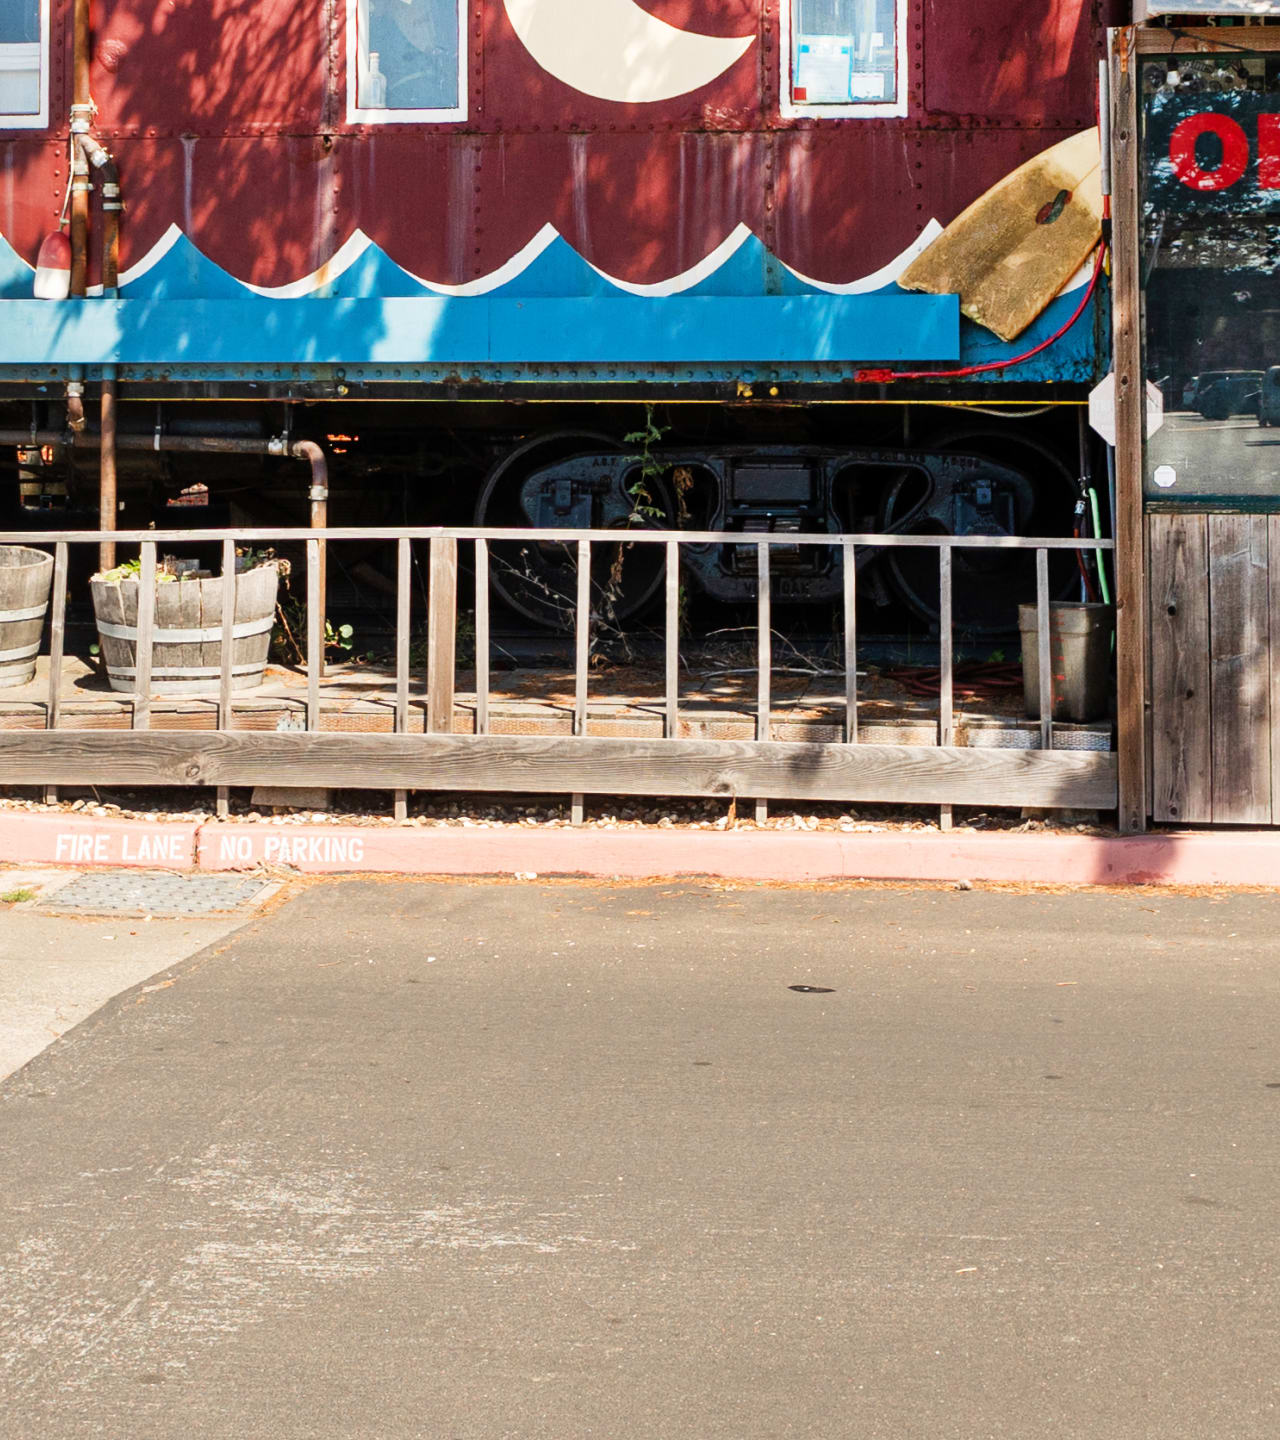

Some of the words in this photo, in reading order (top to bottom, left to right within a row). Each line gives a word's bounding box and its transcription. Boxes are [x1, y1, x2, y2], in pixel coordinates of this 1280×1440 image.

[54, 833, 111, 862] FIRE
[121, 834, 185, 862] LANE
[219, 835, 253, 862] NO
[264, 836, 365, 863] PARKING
